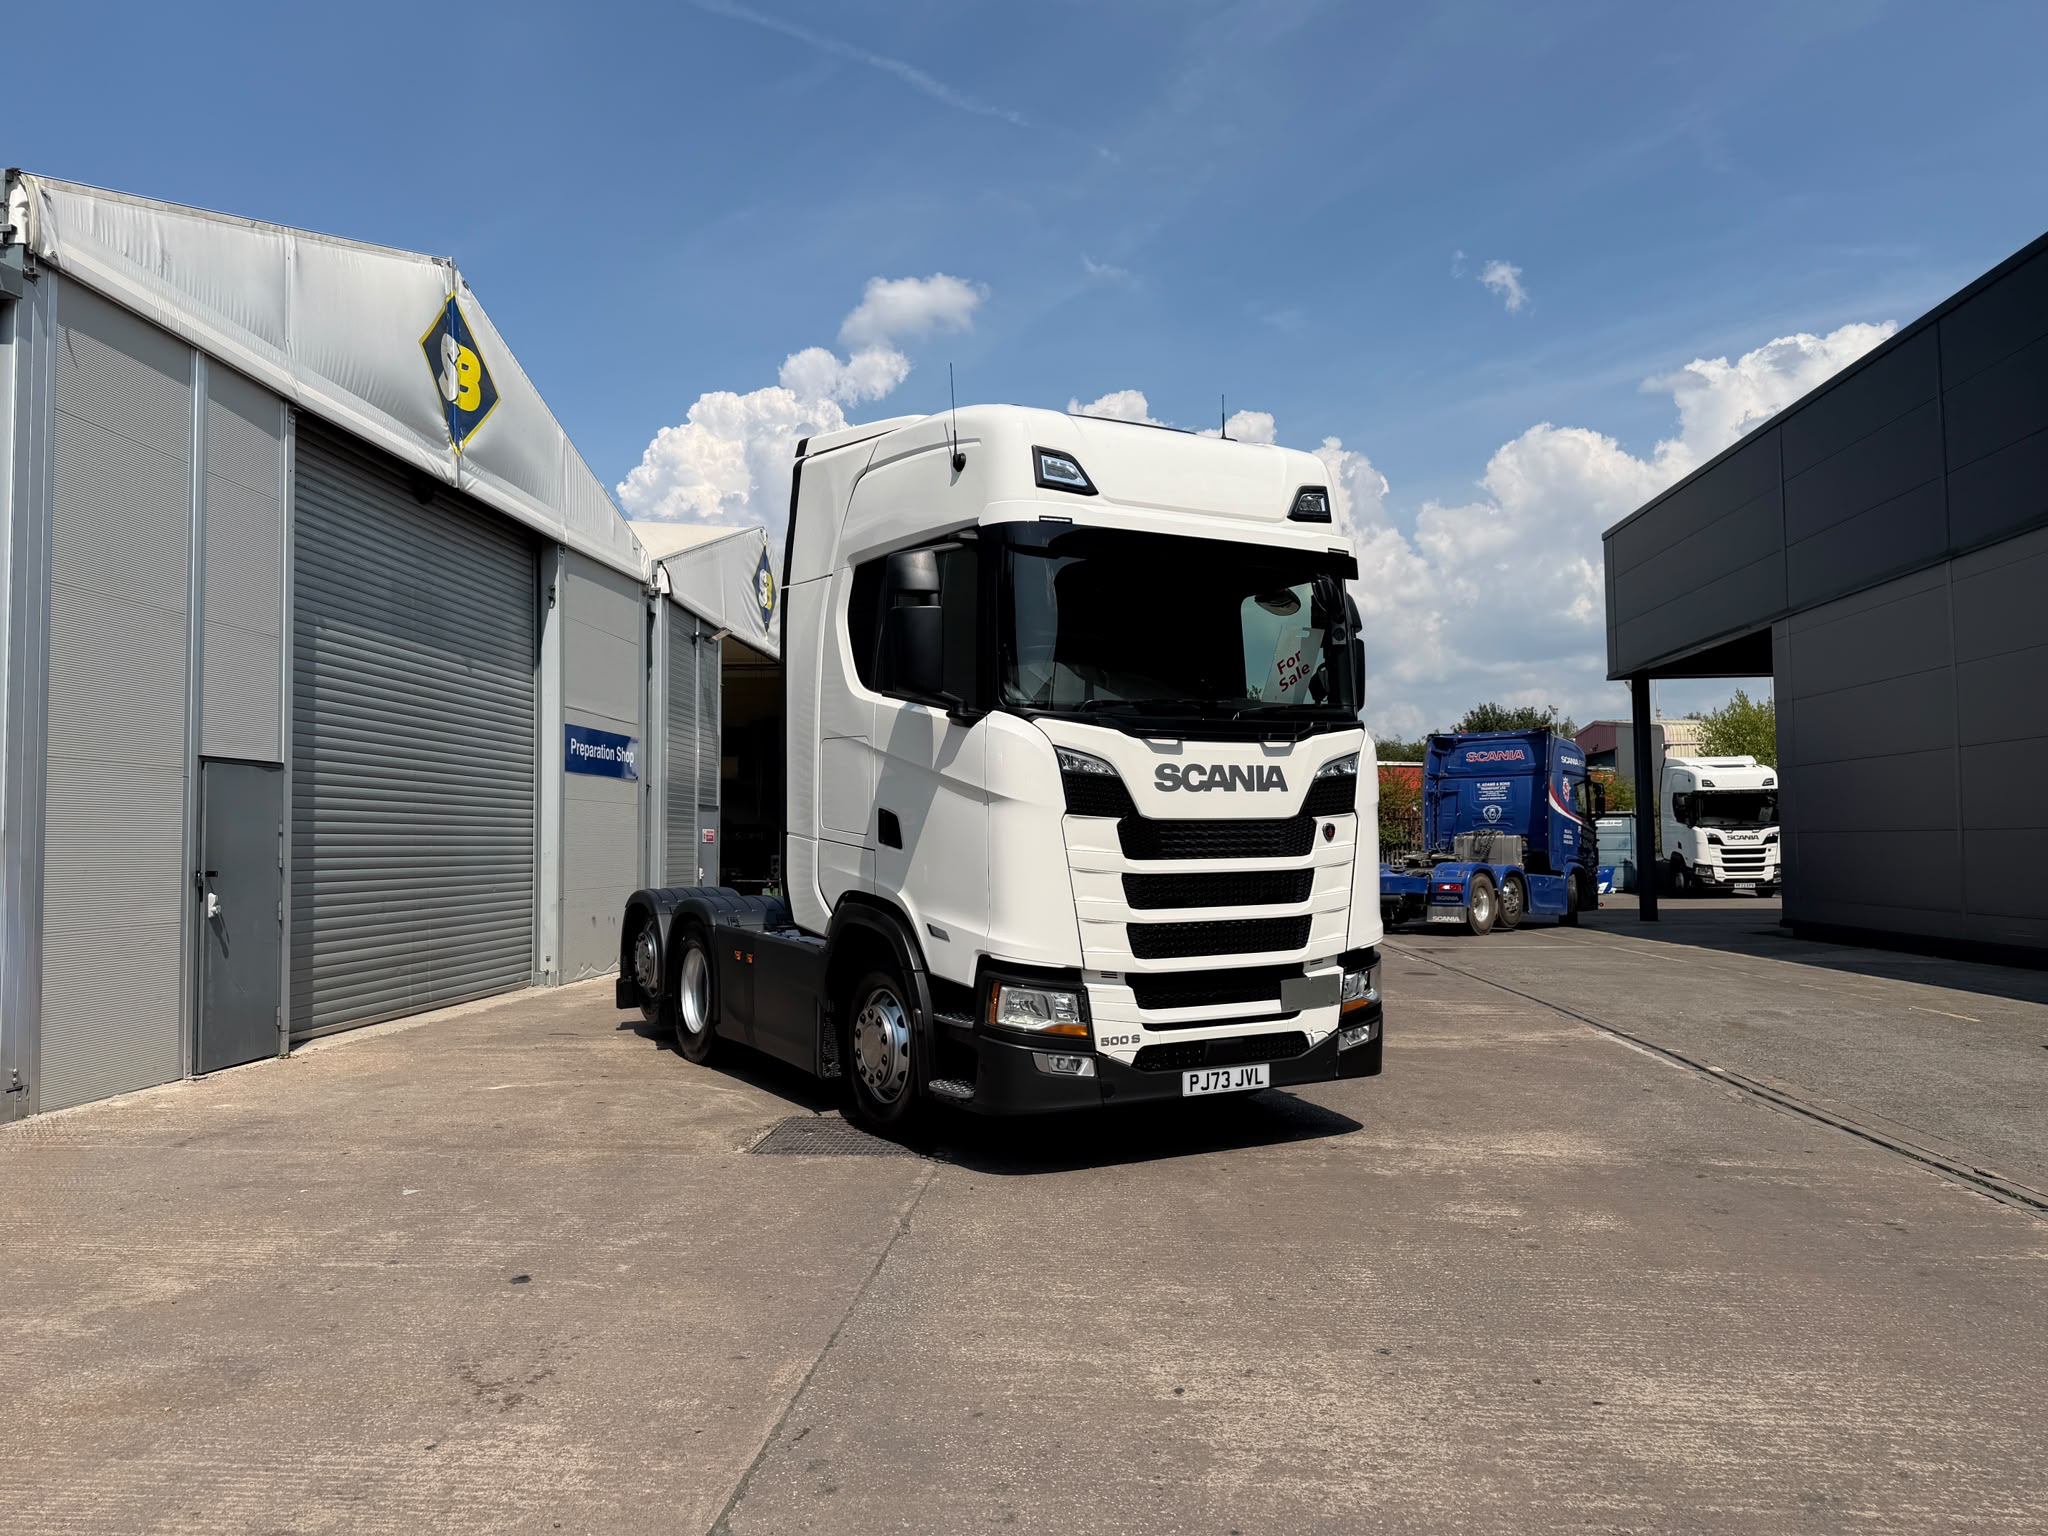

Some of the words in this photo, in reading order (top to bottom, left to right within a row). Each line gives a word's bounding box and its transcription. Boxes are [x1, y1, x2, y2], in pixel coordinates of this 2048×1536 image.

[1276, 650, 1301, 676] For
[1278, 663, 1311, 692] Sale
[570, 737, 615, 761] Preparation
[616, 745, 634, 767] Shop
[1466, 750, 1525, 762] SCANIA
[1154, 763, 1288, 792] SCANIA
[1100, 1035, 1129, 1047] 500
[1131, 1034, 1141, 1044] S
[1189, 1071, 1230, 1093] PJ73
[1235, 1067, 1264, 1087] JVL
